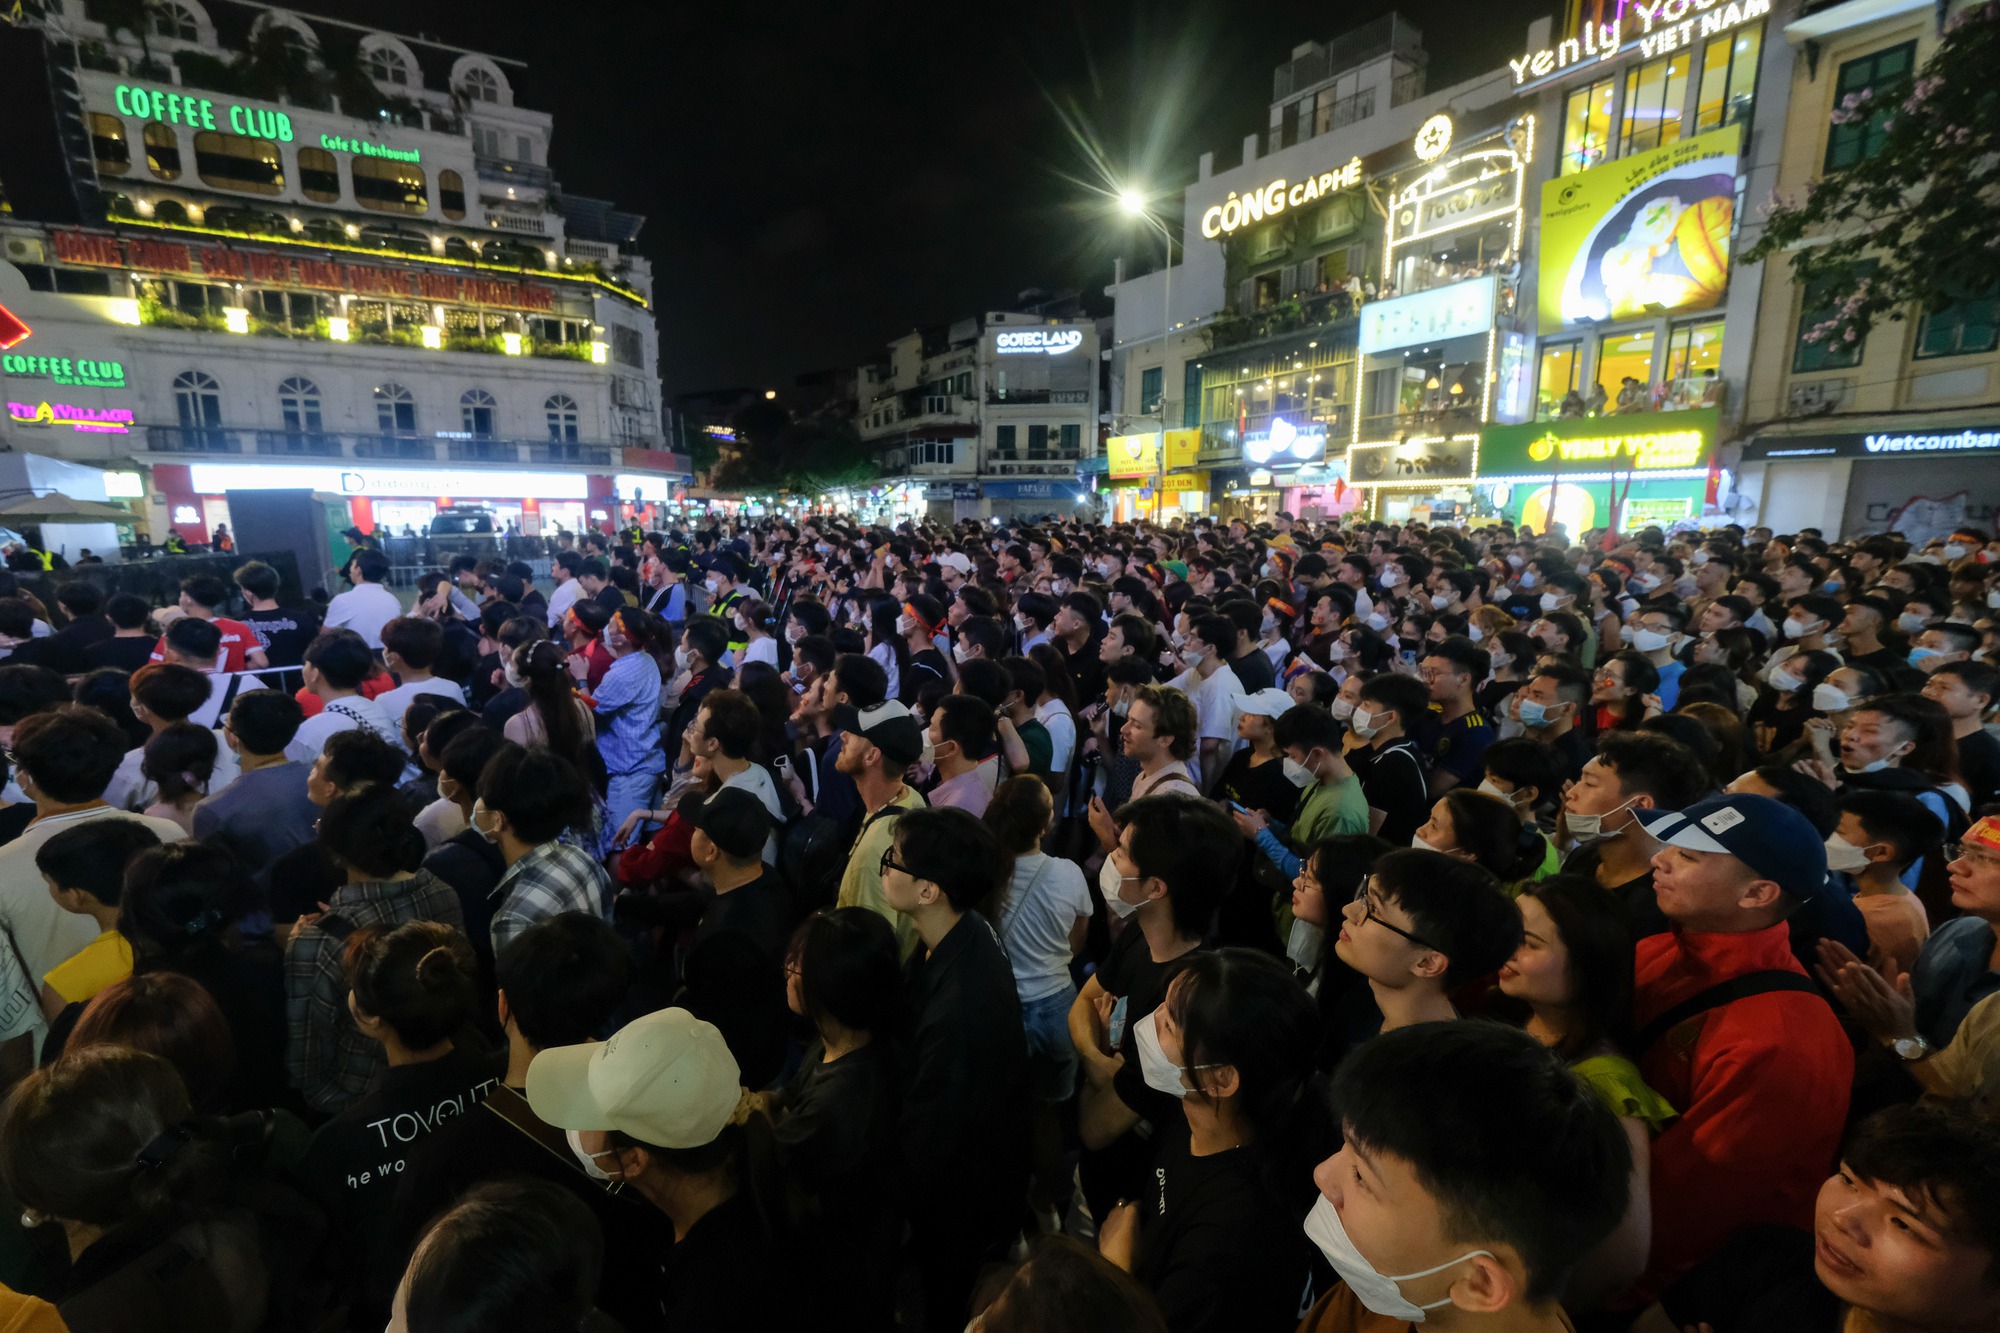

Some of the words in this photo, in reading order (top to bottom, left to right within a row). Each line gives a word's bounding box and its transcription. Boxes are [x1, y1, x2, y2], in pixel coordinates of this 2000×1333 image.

[1639, 18, 1695, 59] VIET
[1700, 0, 1771, 38] NAM
[114, 84, 217, 131] COFFEE
[229, 105, 294, 142] CLUB
[351, 139, 361, 154] &
[362, 141, 420, 163] Restaurant
[2, 354, 73, 376] COFFEE
[77, 358, 125, 379] CLUB
[1865, 430, 2000, 452] Vietcomban
